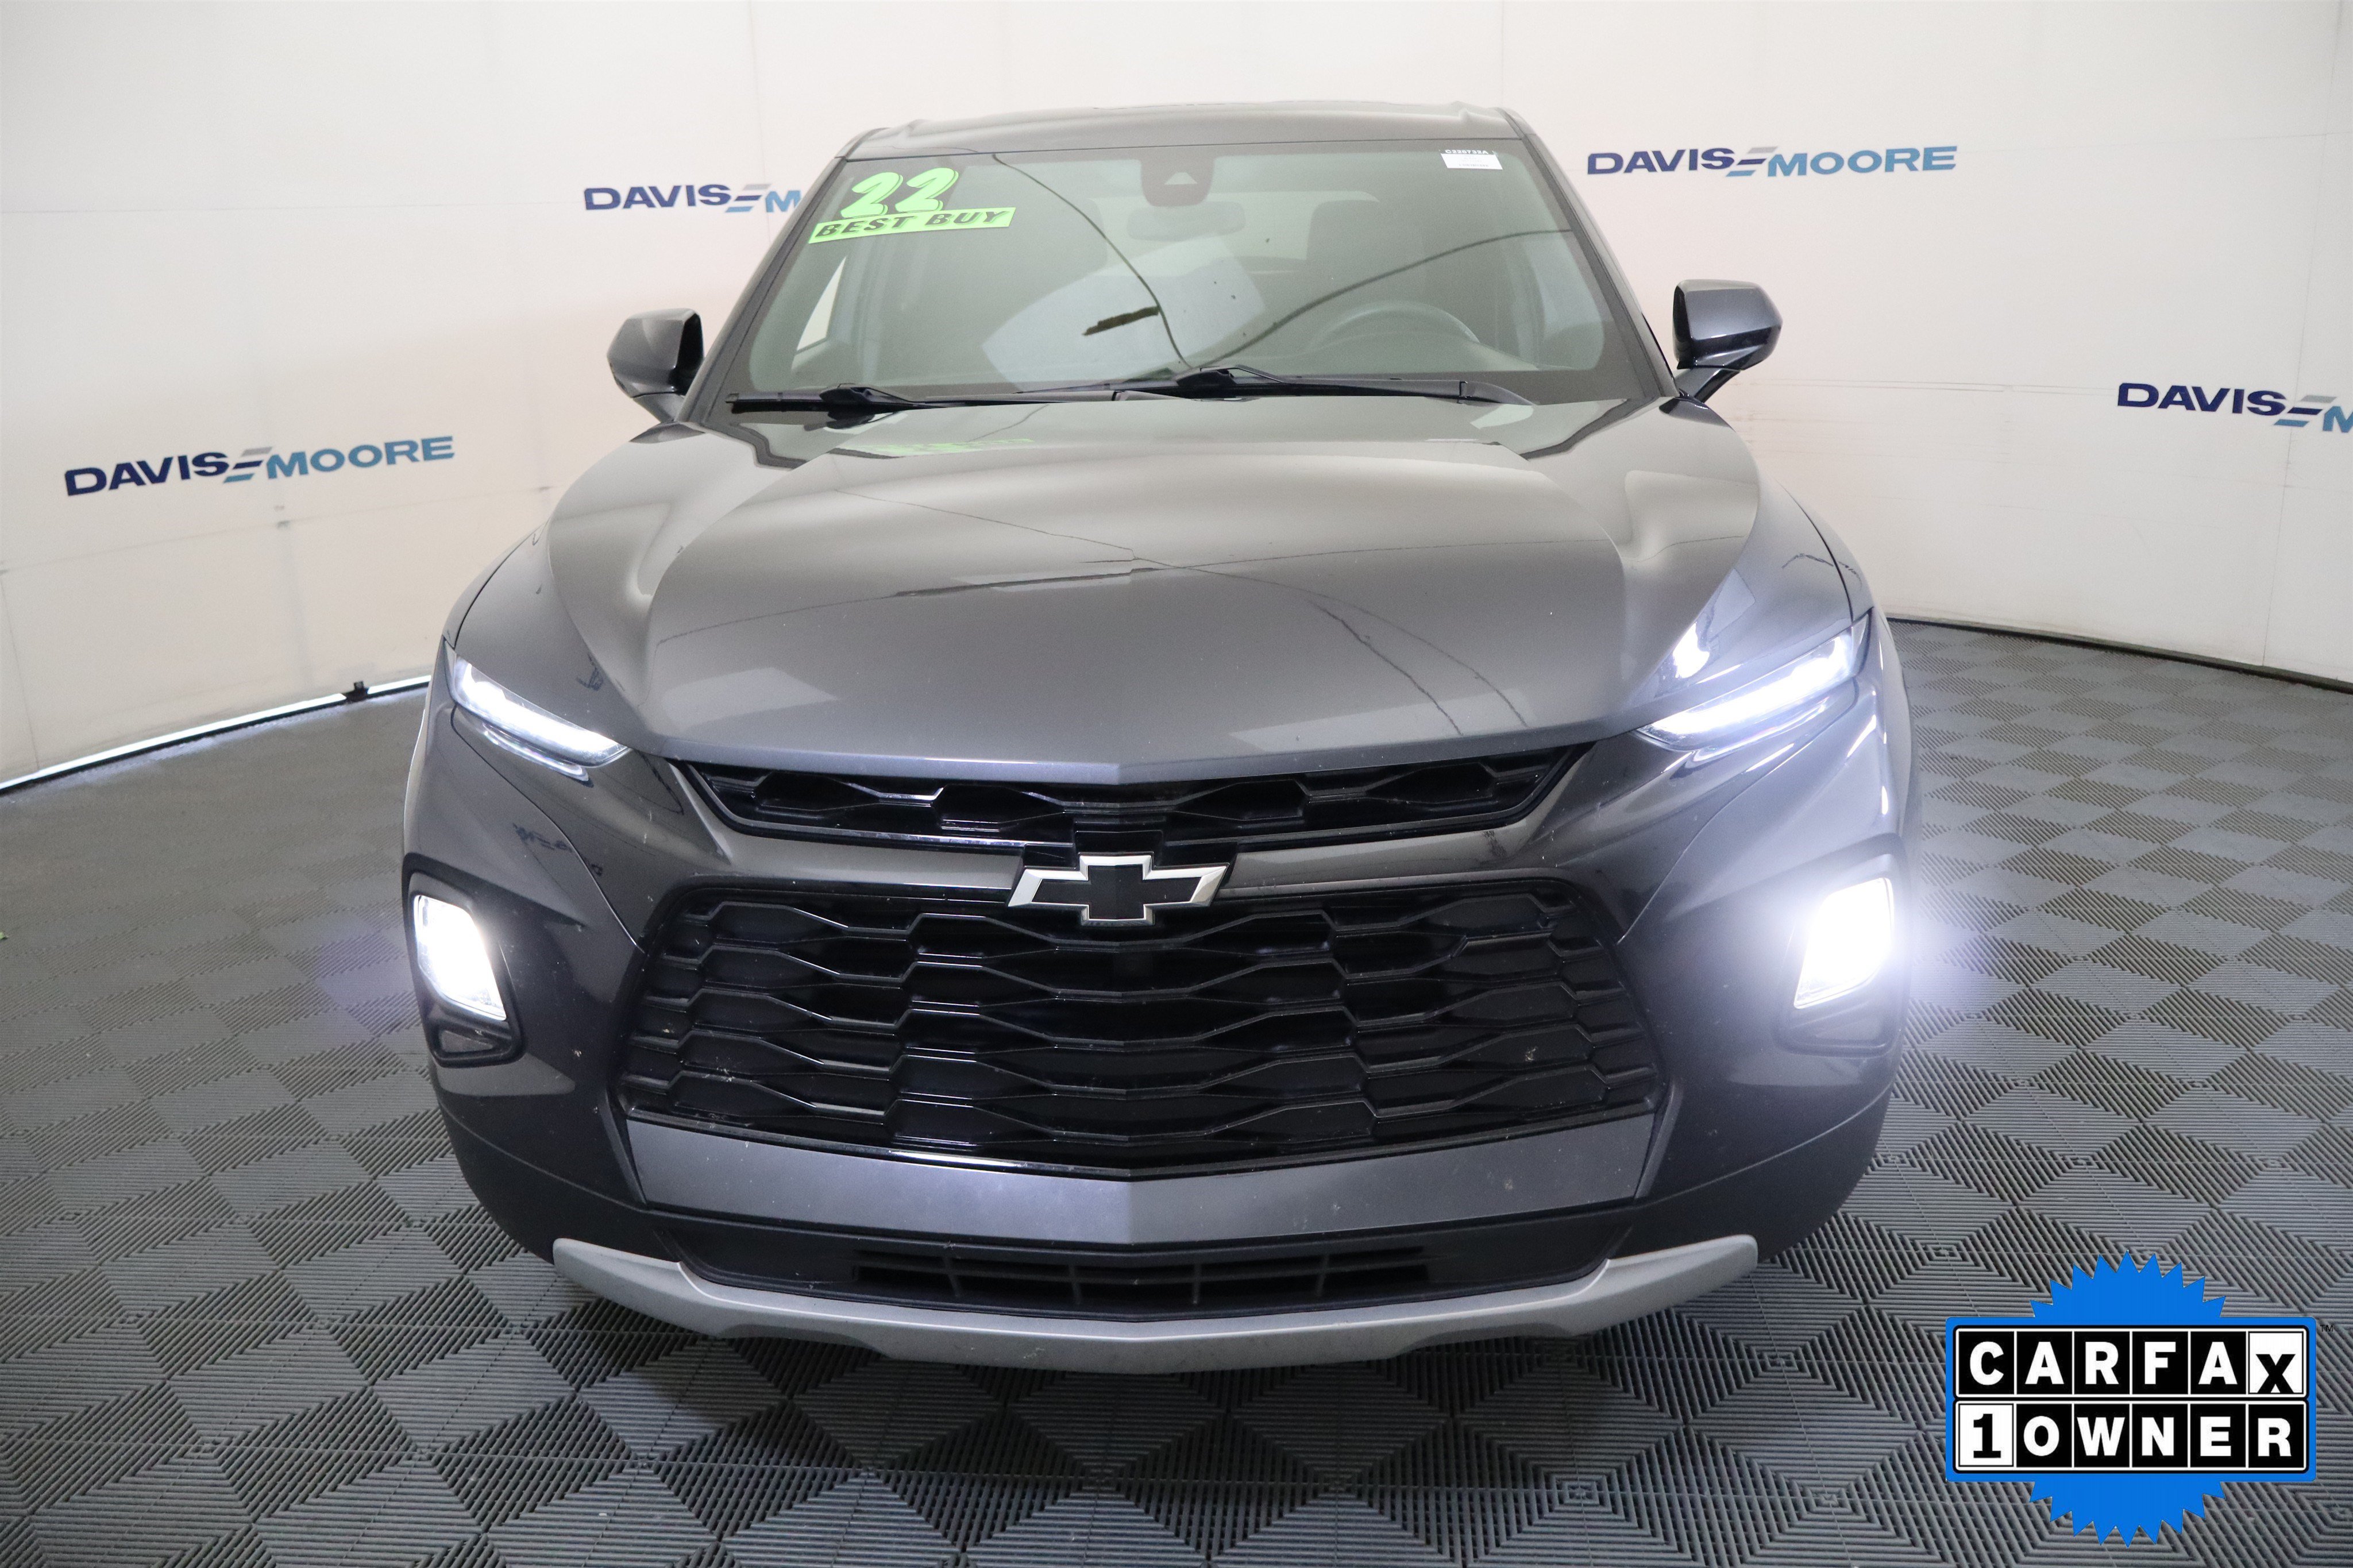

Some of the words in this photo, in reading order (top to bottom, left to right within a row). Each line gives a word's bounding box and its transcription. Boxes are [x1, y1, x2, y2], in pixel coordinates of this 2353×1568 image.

[1587, 148, 1734, 174] DAVIS
[1768, 146, 1958, 177] MOORE
[584, 184, 731, 210] DAVIS
[839, 167, 959, 218] 22
[815, 215, 915, 237] BEST
[926, 210, 1010, 225] BUY
[2117, 383, 2288, 416] DAVIS
[64, 452, 230, 496] DAVIS
[267, 436, 454, 479] MOORE
